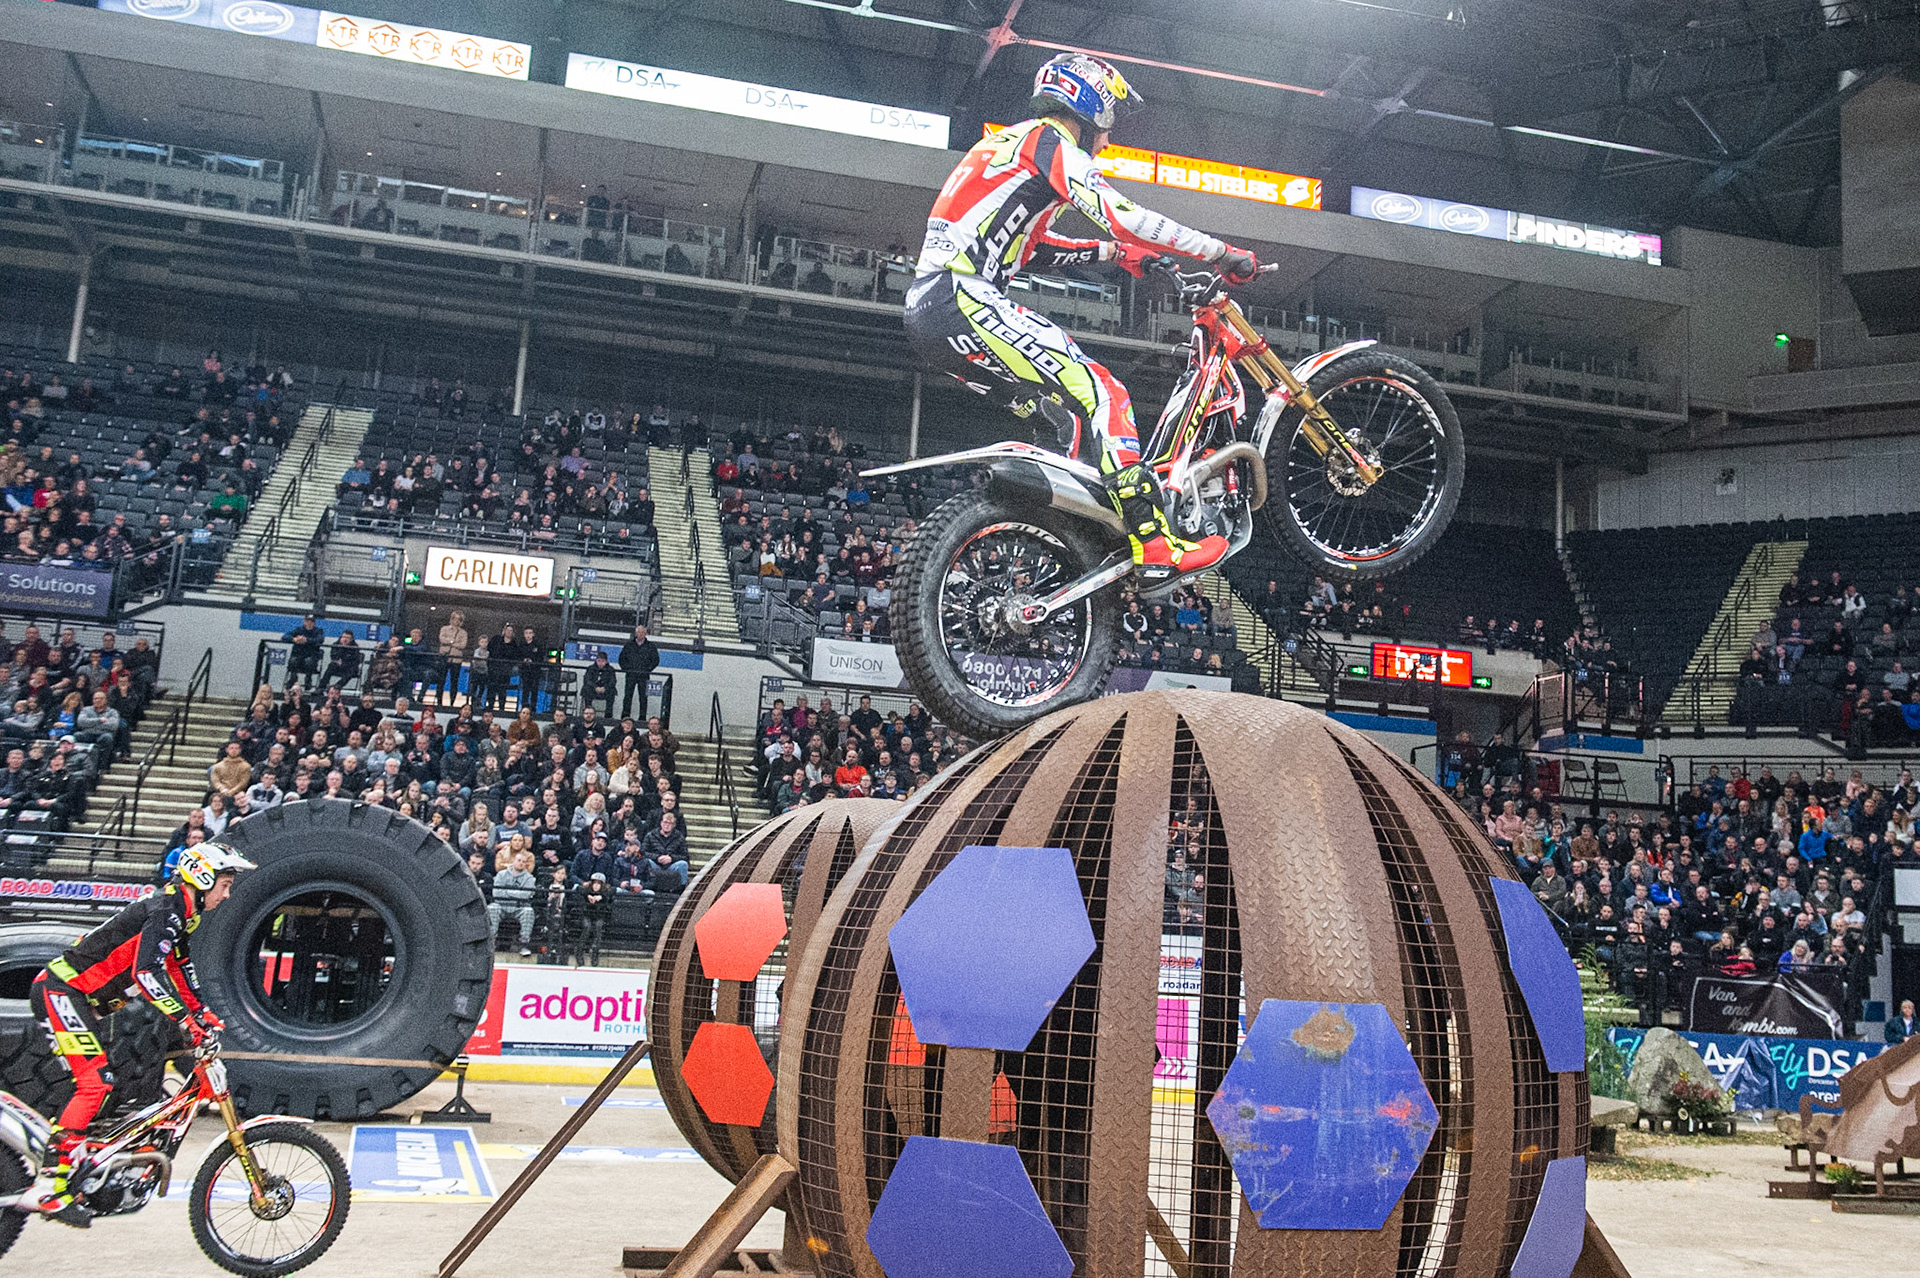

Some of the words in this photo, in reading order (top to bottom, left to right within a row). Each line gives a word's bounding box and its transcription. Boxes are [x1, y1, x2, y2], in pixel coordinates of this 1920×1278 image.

[326, 24, 358, 41] KTR
[368, 31, 400, 47] KTR
[451, 45, 483, 61] KTR
[493, 52, 524, 68] KTR
[616, 65, 668, 89] DSA
[746, 87, 794, 110] DSA
[870, 107, 918, 130] DSA
[1517, 218, 1641, 259] PINDERS
[1052, 250, 1093, 265] TRS
[970, 306, 1066, 376] hebo
[441, 556, 539, 589] CARLING
[8, 573, 96, 595] Solutions
[829, 655, 883, 672] UNISON
[519, 987, 648, 1032] adopti
